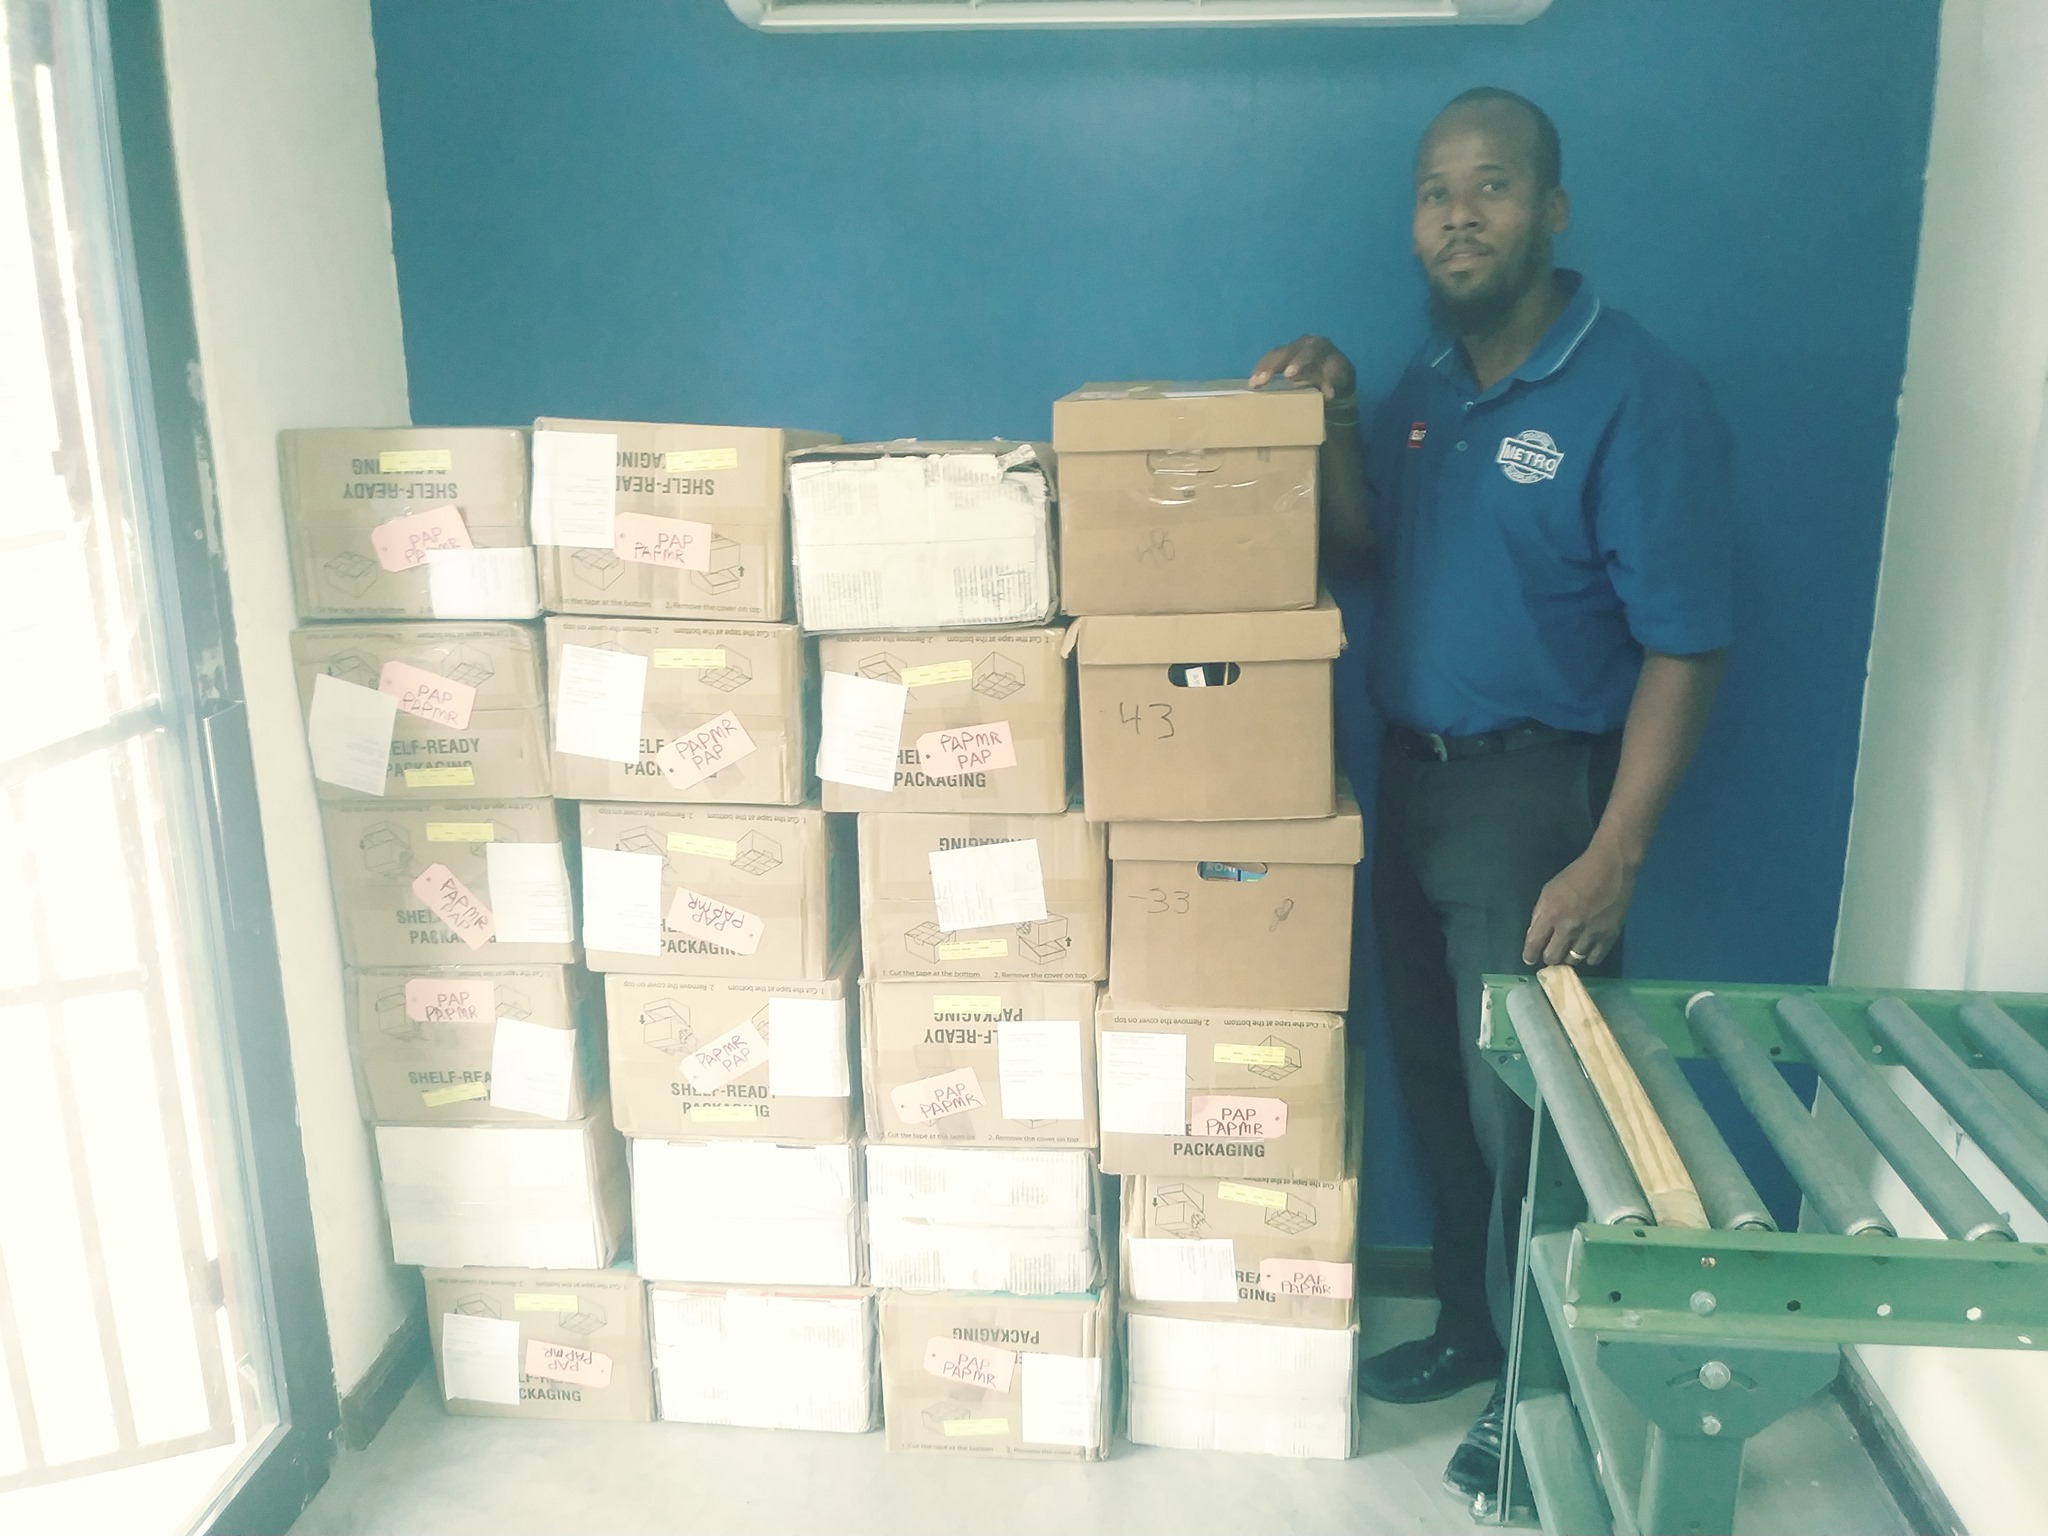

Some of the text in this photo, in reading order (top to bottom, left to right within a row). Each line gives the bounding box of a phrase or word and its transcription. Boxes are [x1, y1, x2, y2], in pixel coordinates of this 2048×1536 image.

[1501, 443, 1558, 473] METRO
[343, 482, 458, 499] SHELF-READY
[409, 526, 444, 551] PAP
[658, 533, 694, 550] PAP
[417, 684, 453, 702] PAP
[1119, 701, 1175, 740] 43
[391, 738, 480, 755] ELF-READY
[691, 743, 725, 771] PAP
[956, 749, 992, 770] PAP
[692, 910, 727, 932] PAP
[889, 968, 902, 976] Cut
[915, 969, 932, 978] tape
[941, 969, 954, 977] the
[954, 969, 981, 978] bottom
[1001, 970, 1030, 978] Remove
[1074, 971, 1088, 980] top
[727, 984, 754, 993] bottom
[754, 984, 768, 993] the
[766, 985, 775, 993] at
[775, 985, 792, 994] tape
[792, 985, 805, 994] the
[805, 986, 818, 995] Cut
[437, 991, 470, 1008] PAP
[1113, 1015, 1127, 1024] top
[1159, 1017, 1173, 1026] the
[1172, 1017, 1203, 1027] Remove
[1223, 1019, 1251, 1028] bottom
[1252, 1019, 1266, 1028] the
[1274, 1020, 1291, 1028] tape
[1291, 1021, 1305, 1029] the
[1305, 1021, 1319, 1029] Cut
[722, 1047, 751, 1073] PAP
[934, 1082, 966, 1102] PAP
[1221, 1107, 1257, 1122] PAP
[995, 1134, 1023, 1142] Remove
[1066, 1136, 1080, 1144] top
[1173, 1142, 1265, 1158] PACKAGING
[1294, 1272, 1326, 1285] PAP
[953, 1327, 1040, 1345] PACKAGING
[548, 1360, 580, 1372] PAP
[958, 1353, 990, 1371] PAP
[519, 1387, 582, 1403] CKAGING
